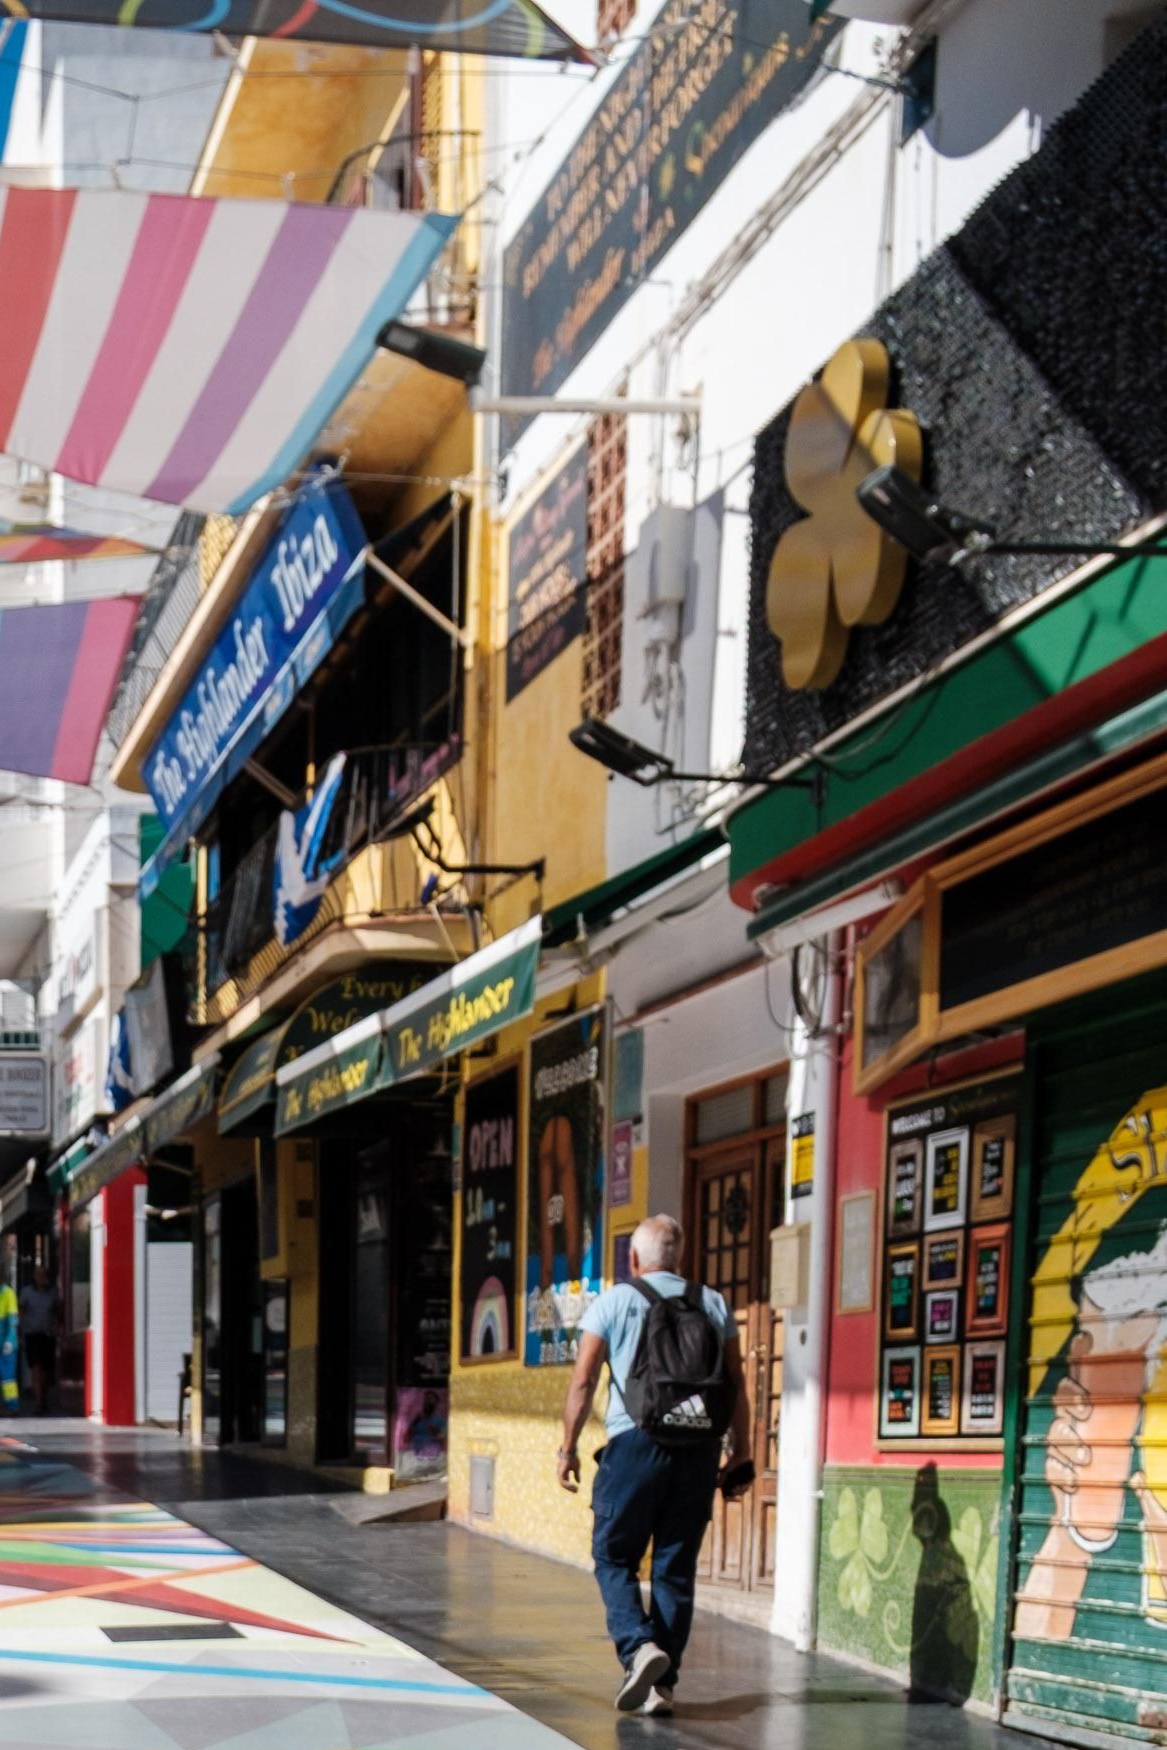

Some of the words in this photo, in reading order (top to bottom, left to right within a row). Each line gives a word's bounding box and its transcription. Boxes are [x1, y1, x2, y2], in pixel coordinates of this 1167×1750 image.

[153, 750, 185, 814] The
[177, 616, 269, 781] Highlander
[271, 514, 338, 632] Ibiza
[341, 976, 404, 1000] Every
[399, 1027, 422, 1068] The
[428, 977, 515, 1050] Highlander
[469, 1116, 513, 1171] OPEN
[663, 1413, 712, 1429] adidas
